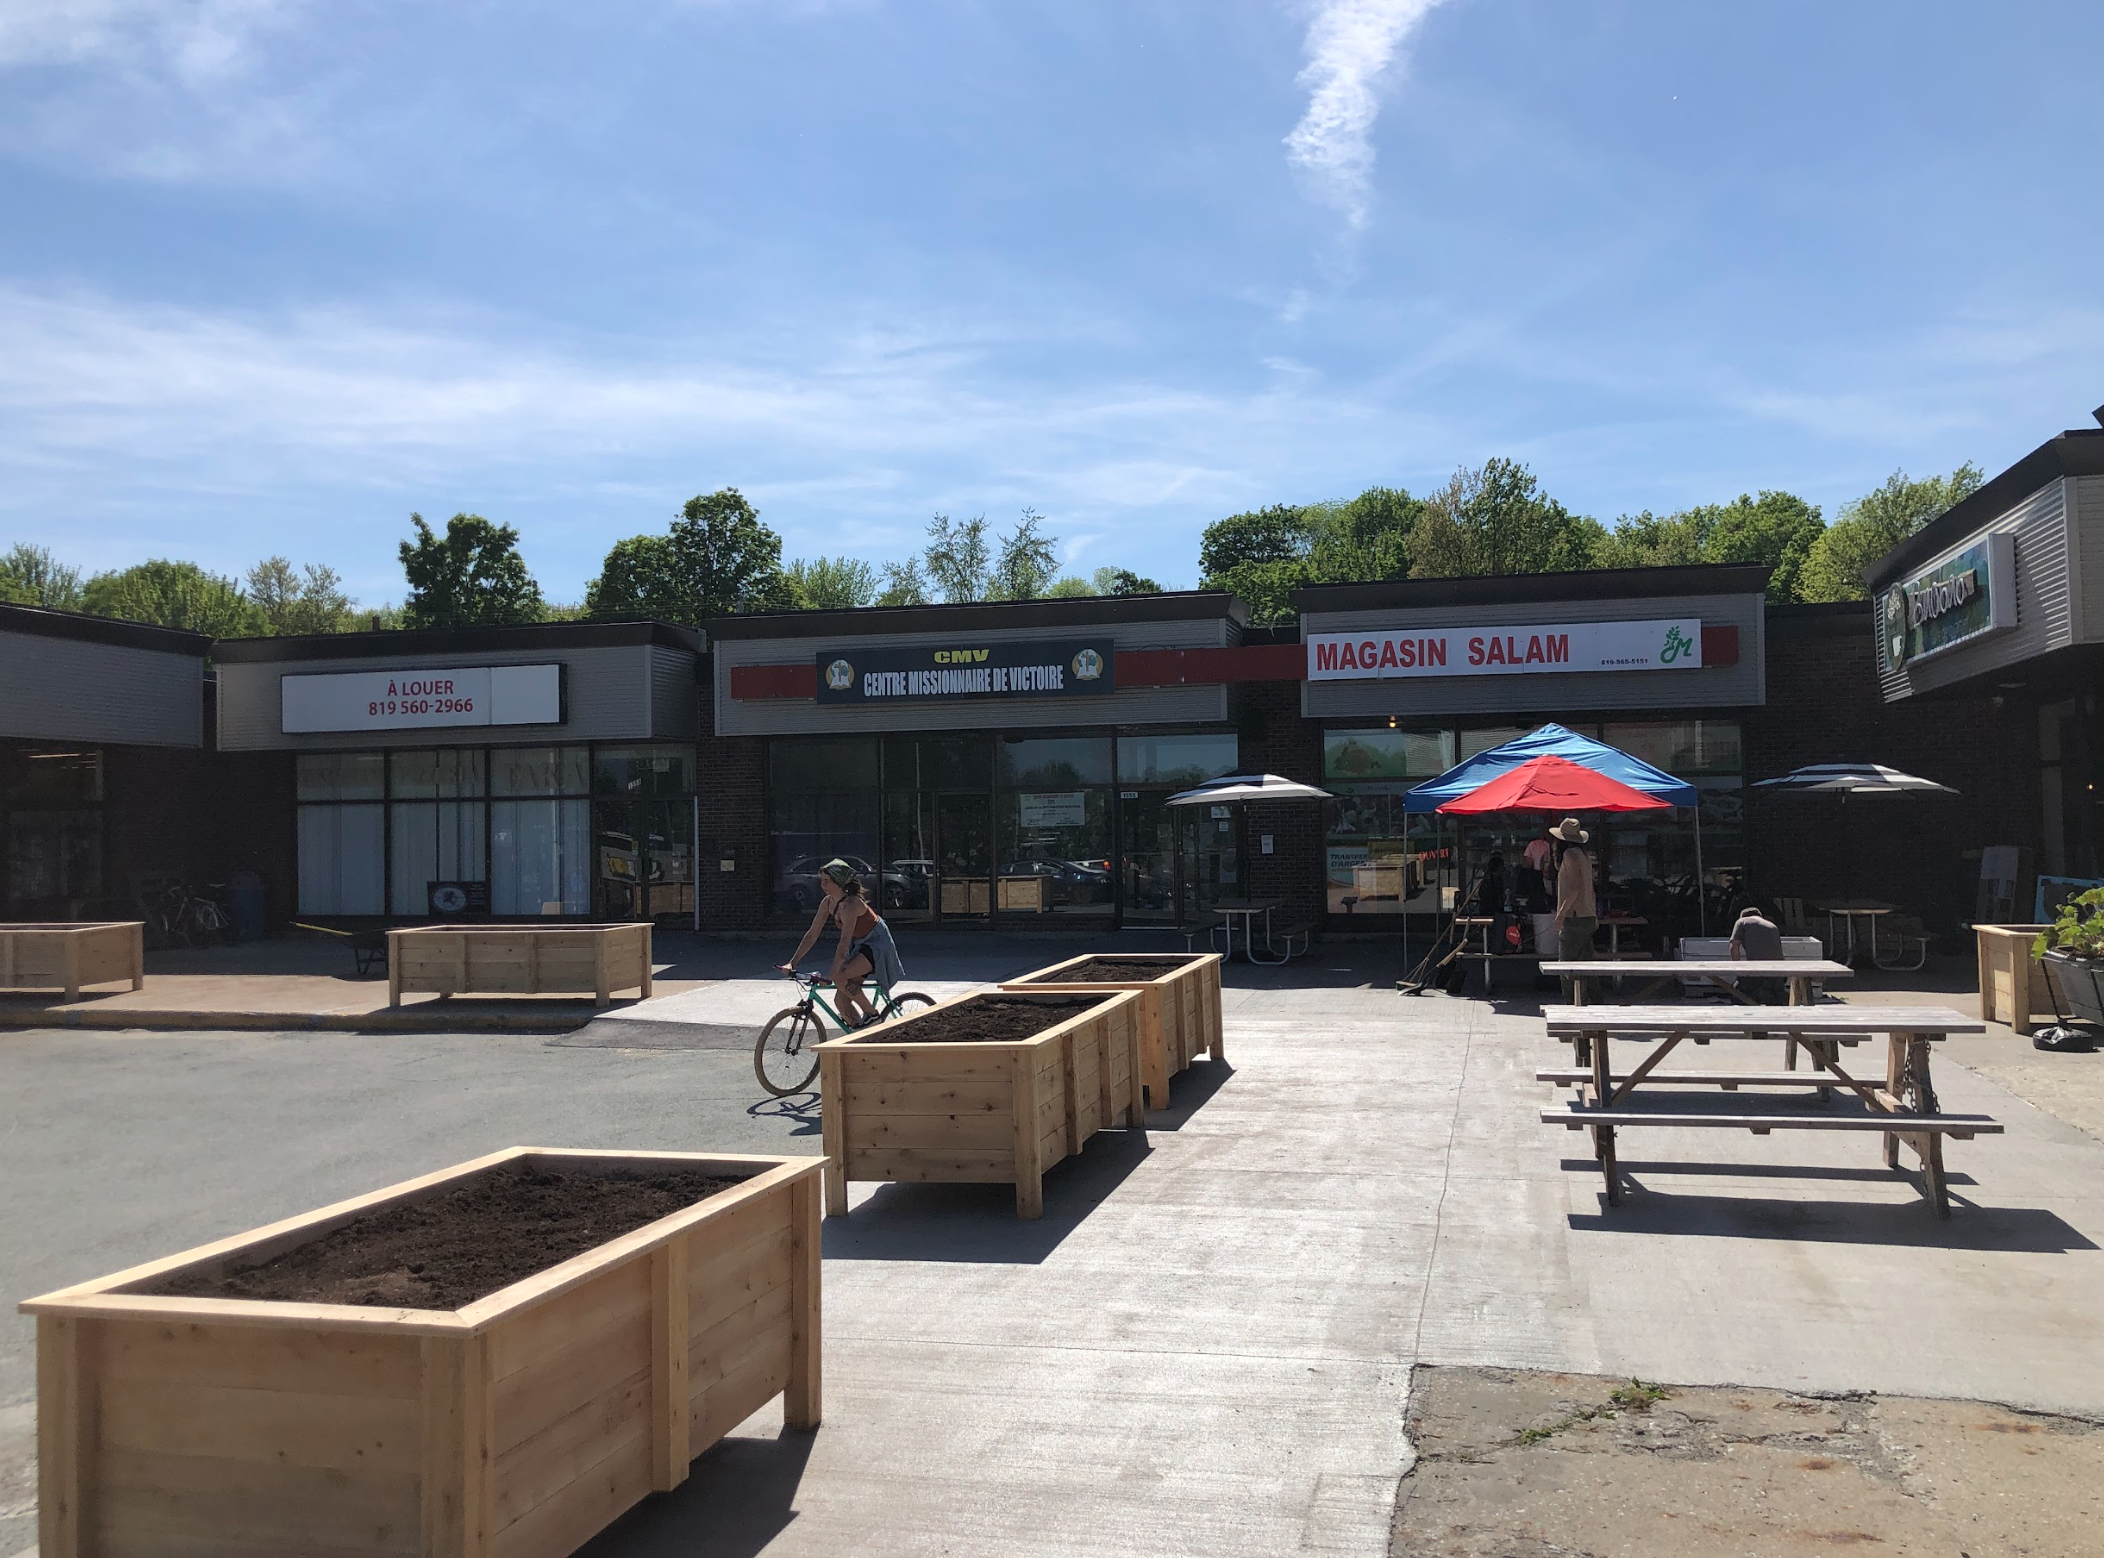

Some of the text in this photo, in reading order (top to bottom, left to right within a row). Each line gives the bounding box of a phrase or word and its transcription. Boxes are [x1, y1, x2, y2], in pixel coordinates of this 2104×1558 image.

[934, 649, 990, 663] CMV
[1317, 634, 1569, 671] MAGASIN SALAM
[387, 679, 454, 697] À LOUER
[863, 665, 1064, 697] CENTRE MISSIONNAIRE DE VICTOIRE
[368, 698, 474, 716] 819 560-2966
[1418, 848, 1449, 862] OUVRT
